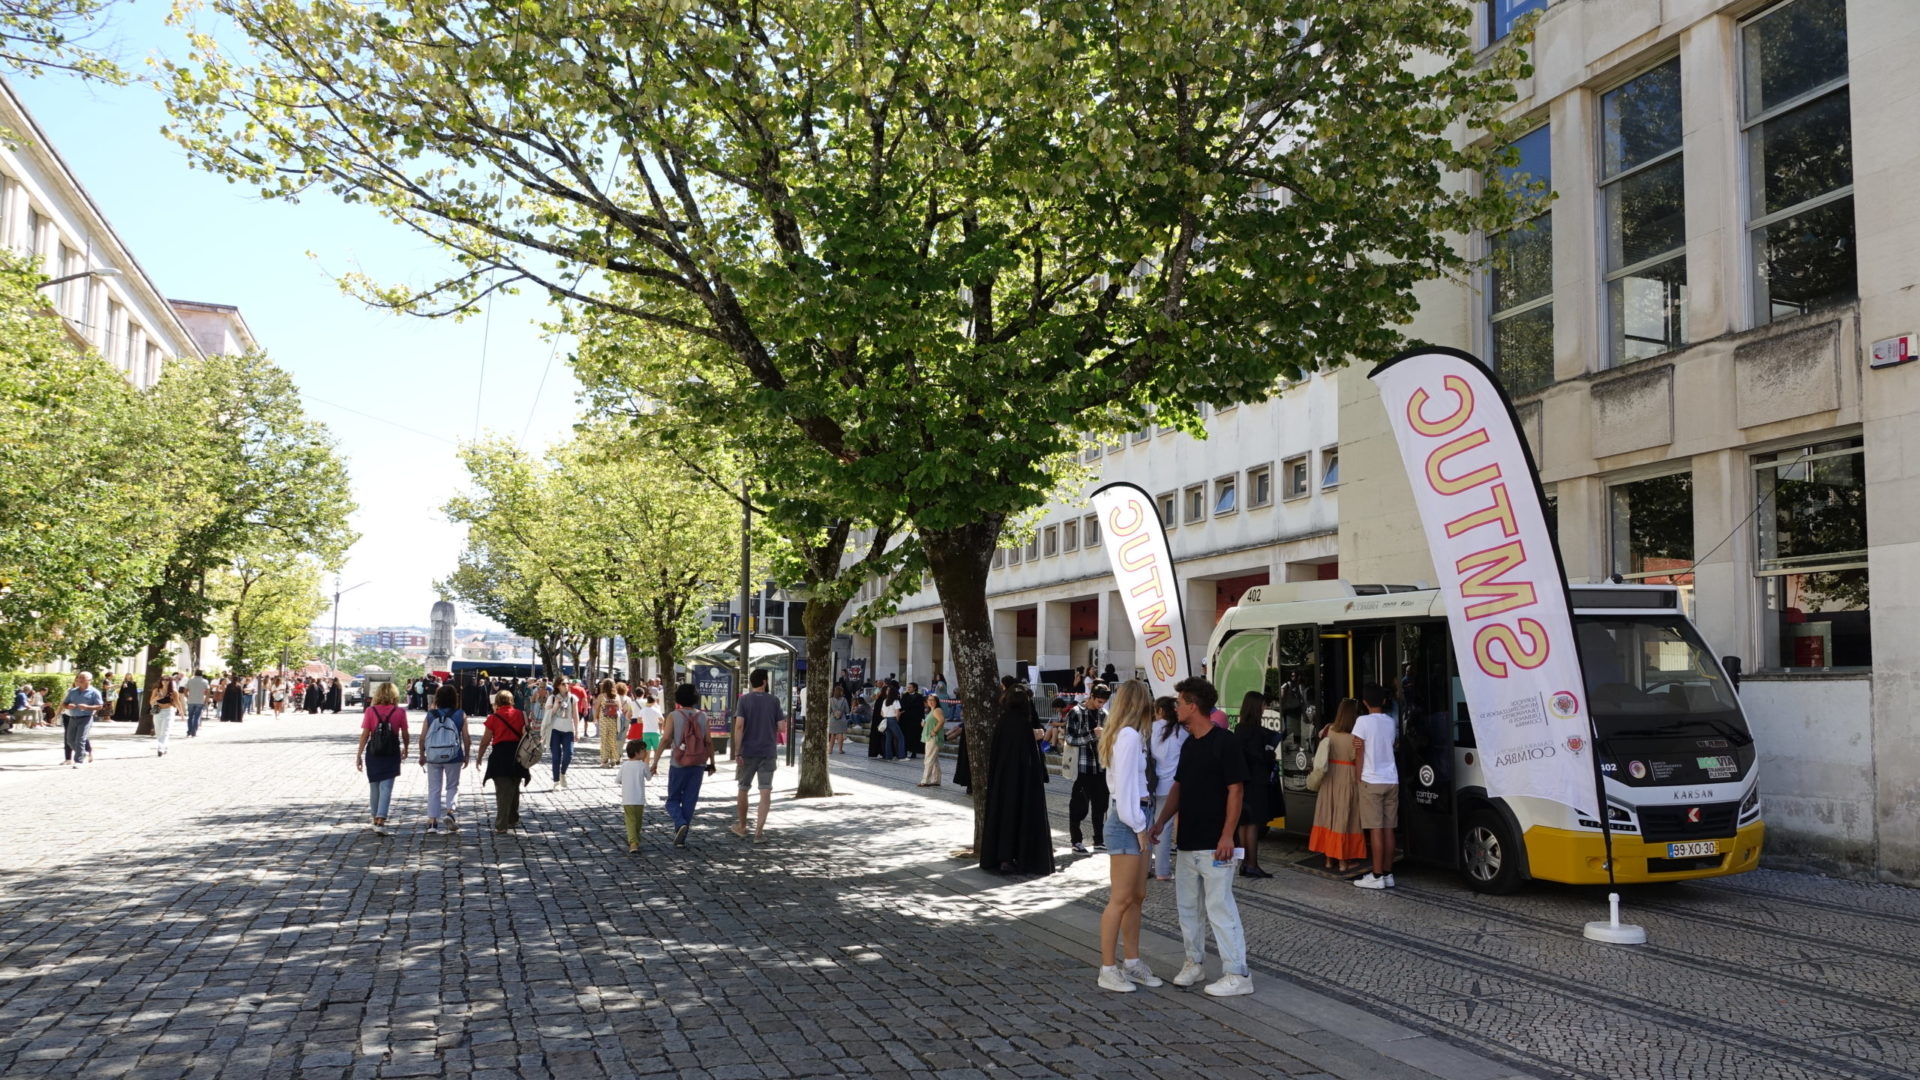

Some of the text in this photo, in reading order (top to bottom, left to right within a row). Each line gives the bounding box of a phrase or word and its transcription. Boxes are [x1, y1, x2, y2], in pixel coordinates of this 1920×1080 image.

[1247, 588, 1261, 602] 402
[720, 695, 727, 711] 1
[1673, 790, 1714, 800] KARSAN
